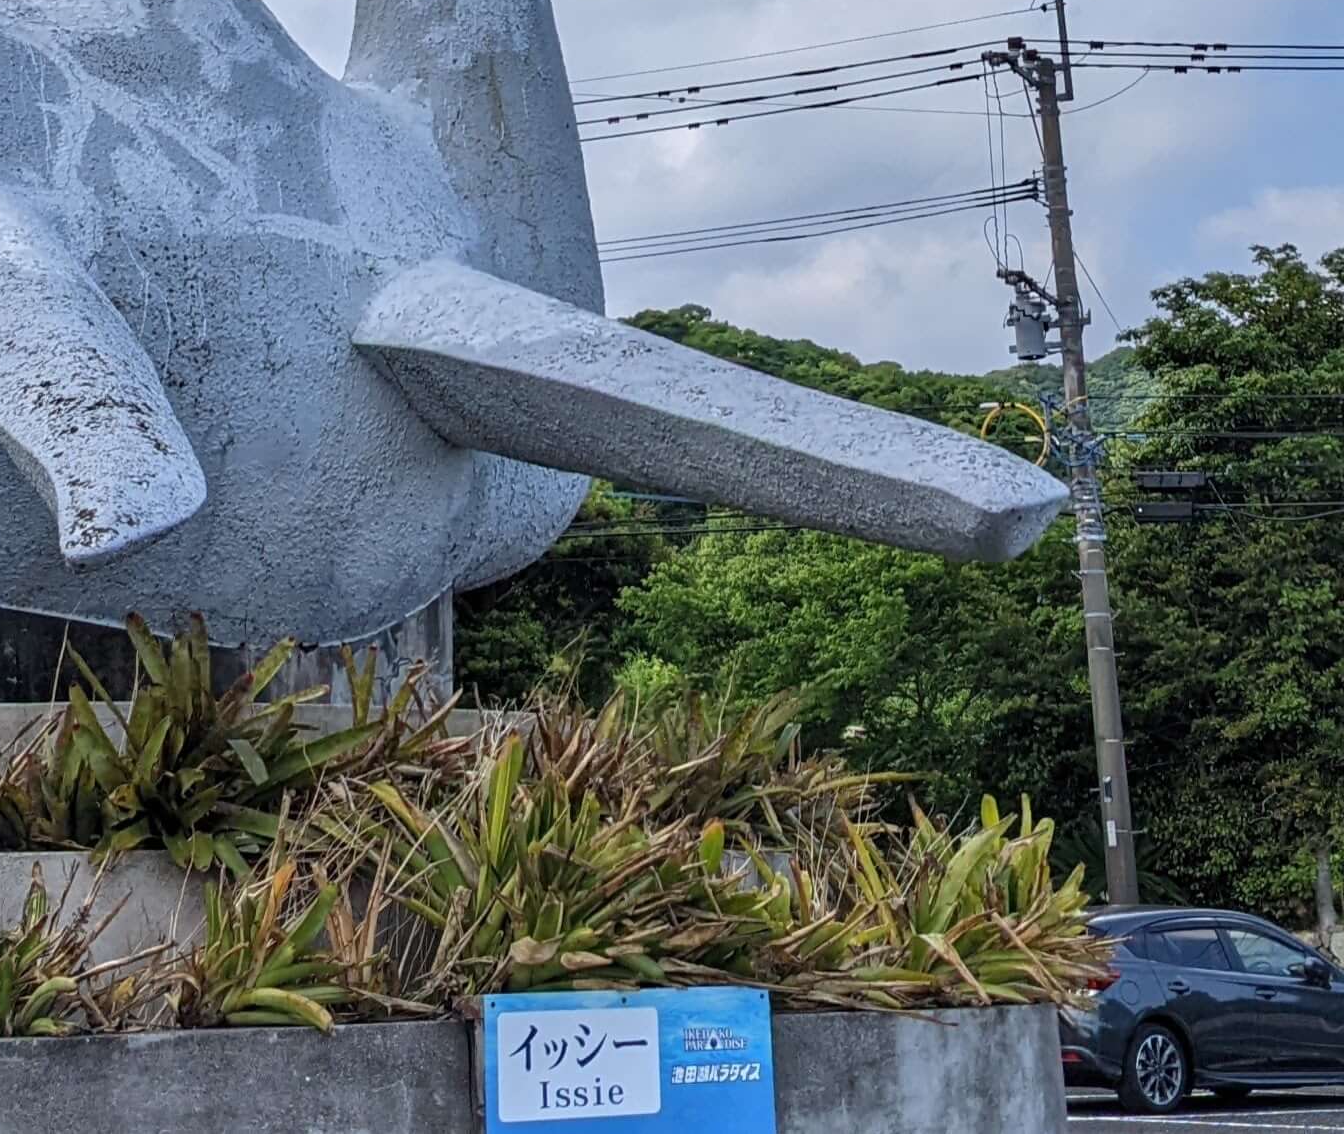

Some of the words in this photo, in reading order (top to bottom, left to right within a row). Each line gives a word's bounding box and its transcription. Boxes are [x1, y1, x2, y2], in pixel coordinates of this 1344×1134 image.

[509, 1023, 649, 1072] イッシー
[539, 1077, 625, 1110] Issie
